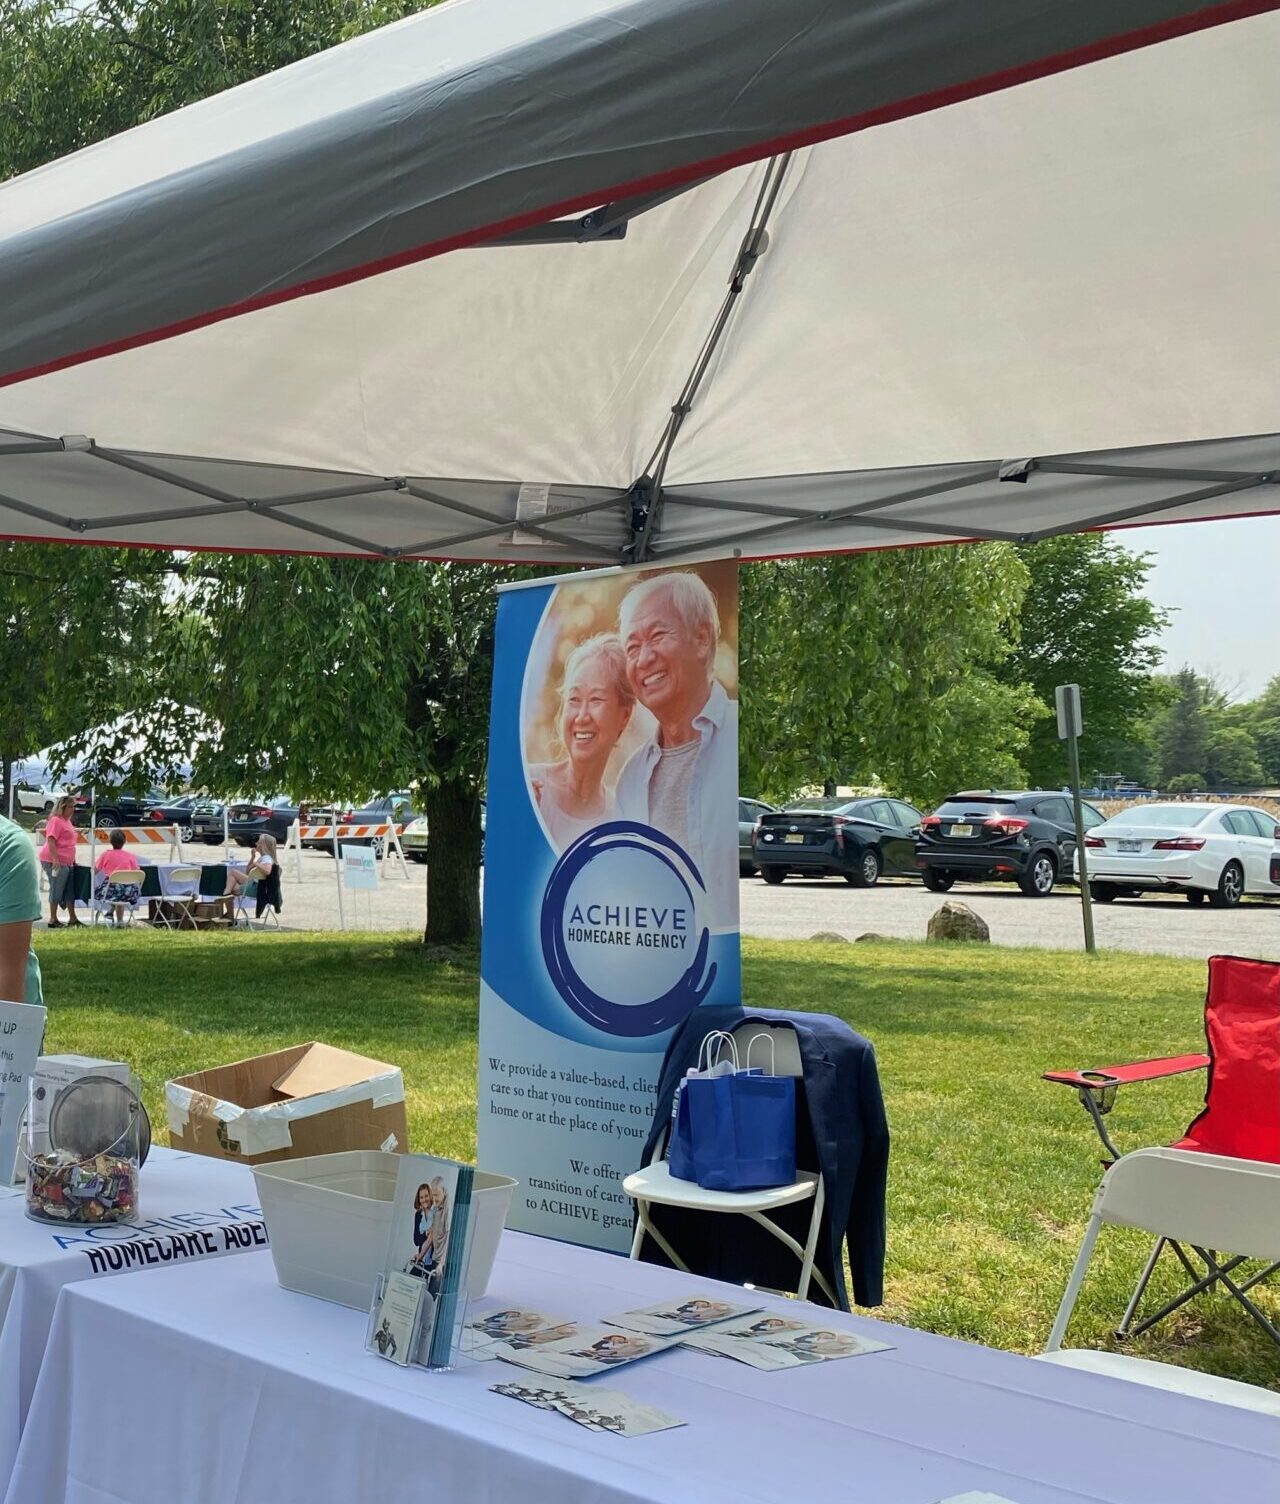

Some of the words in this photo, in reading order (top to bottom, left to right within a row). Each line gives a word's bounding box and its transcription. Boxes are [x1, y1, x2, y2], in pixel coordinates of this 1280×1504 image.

[570, 904, 686, 930] ACHIEVE
[568, 928, 631, 945] HOMECARE
[636, 933, 687, 949] AGENCY
[3, 1022, 17, 1035] UP
[1, 1050, 14, 1061] this
[8, 1072, 22, 1083] Pad
[489, 1057, 506, 1072] We
[508, 1063, 548, 1078] provide
[551, 1070, 557, 1080] a
[559, 1068, 630, 1092] value-based,
[491, 1082, 511, 1095] care
[513, 1086, 525, 1097] so
[527, 1085, 548, 1101] that
[551, 1092, 571, 1107] you
[575, 1096, 626, 1112] continue
[629, 1103, 642, 1115] to
[490, 1100, 519, 1118] home
[522, 1111, 533, 1121] or
[536, 1112, 546, 1123] at
[549, 1110, 566, 1126] the
[570, 1114, 598, 1131] place
[601, 1119, 616, 1134] of
[616, 1125, 645, 1140] your
[570, 1159, 589, 1174] We
[593, 1163, 621, 1181] offer
[528, 1177, 582, 1196] transition
[585, 1184, 599, 1199] of
[601, 1190, 625, 1204] care
[526, 1198, 538, 1209] to
[540, 1199, 600, 1222] ACHIEVE
[603, 1214, 633, 1229] great
[80, 1229, 218, 1273] HOMECARE
